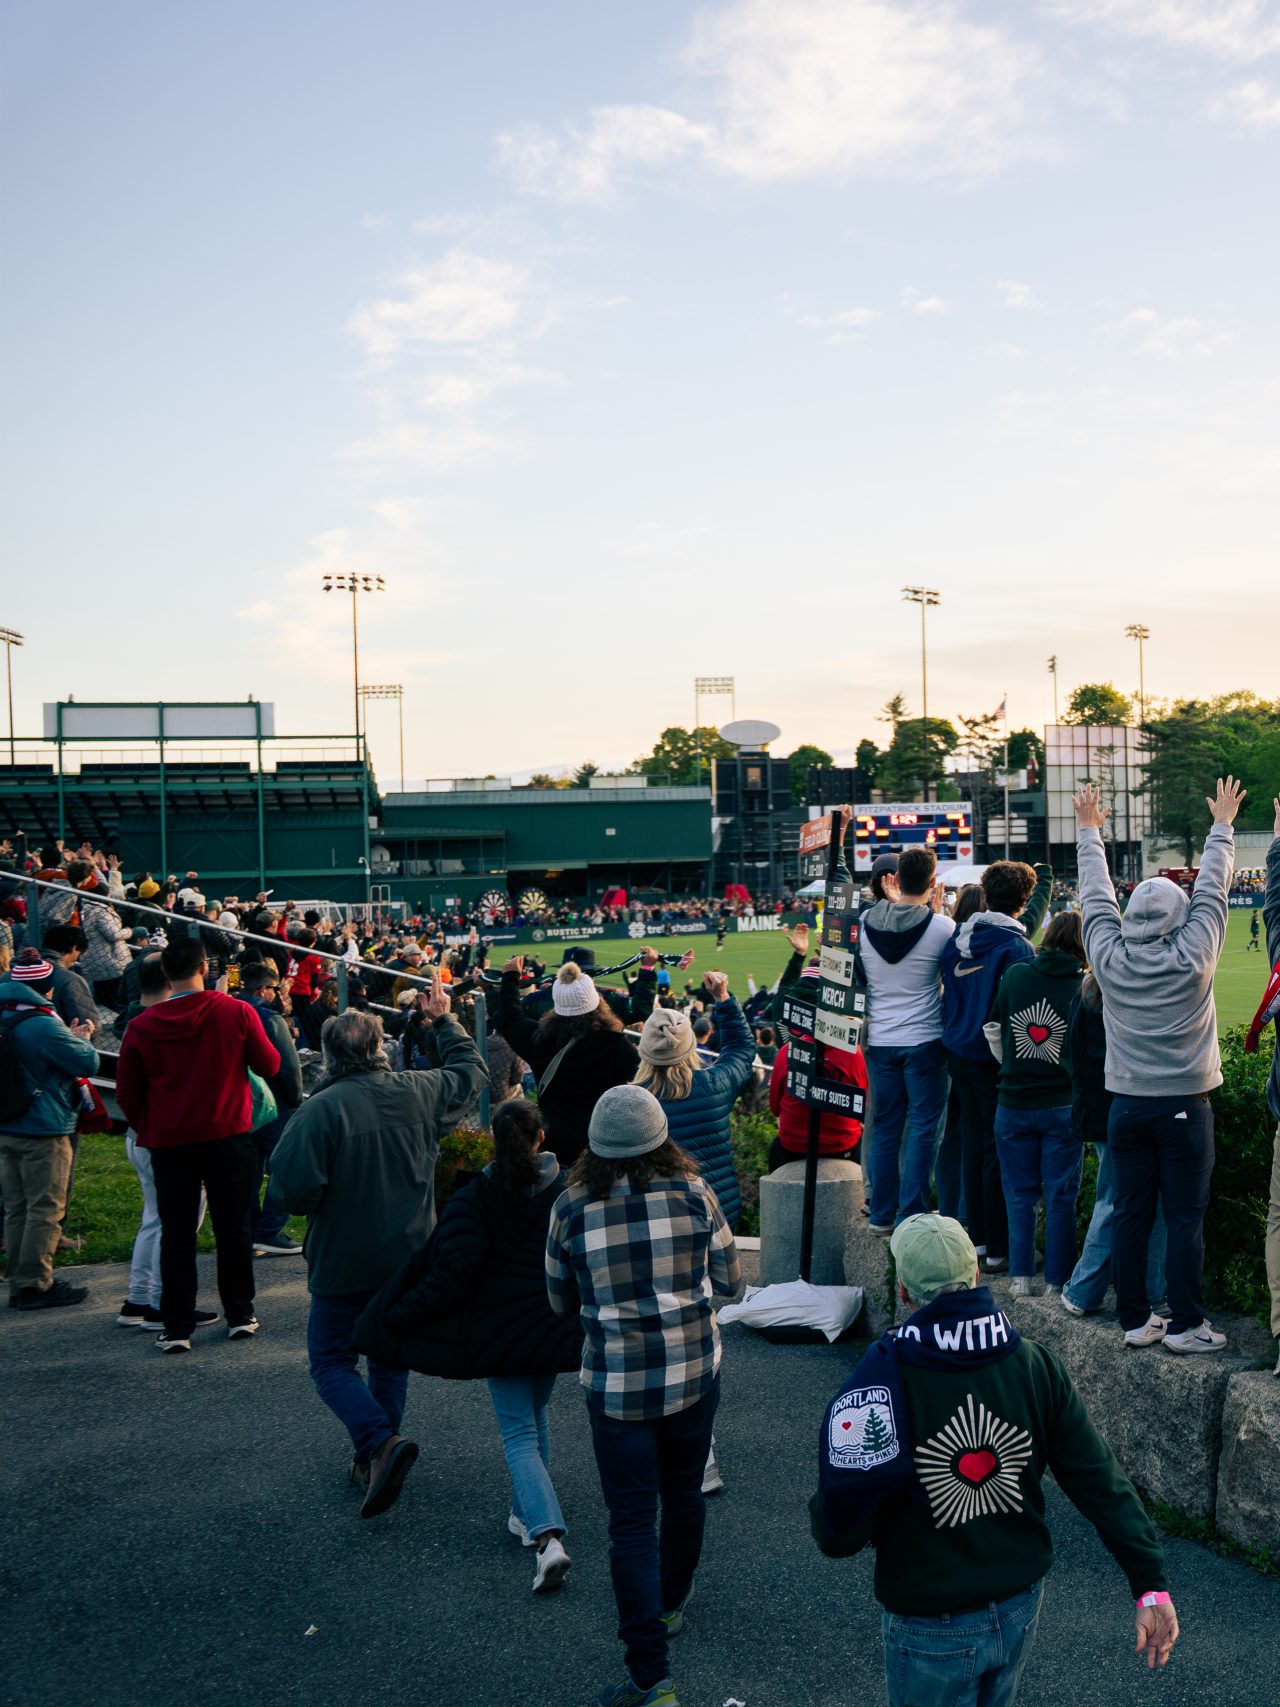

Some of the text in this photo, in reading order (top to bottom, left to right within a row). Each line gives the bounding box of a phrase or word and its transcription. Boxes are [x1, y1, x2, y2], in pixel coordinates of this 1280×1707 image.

[859, 806, 921, 814] FITZPATRICK
[546, 926, 604, 937] RUSTIC TAPS
[821, 985, 846, 1009] MERCH
[829, 1024, 847, 1042] DRINK
[811, 1086, 850, 1108] PARTY SUITES
[834, 1389, 888, 1416] PORTLAND
[837, 1456, 867, 1465] HEARTS
[874, 1448, 893, 1461] PINE
